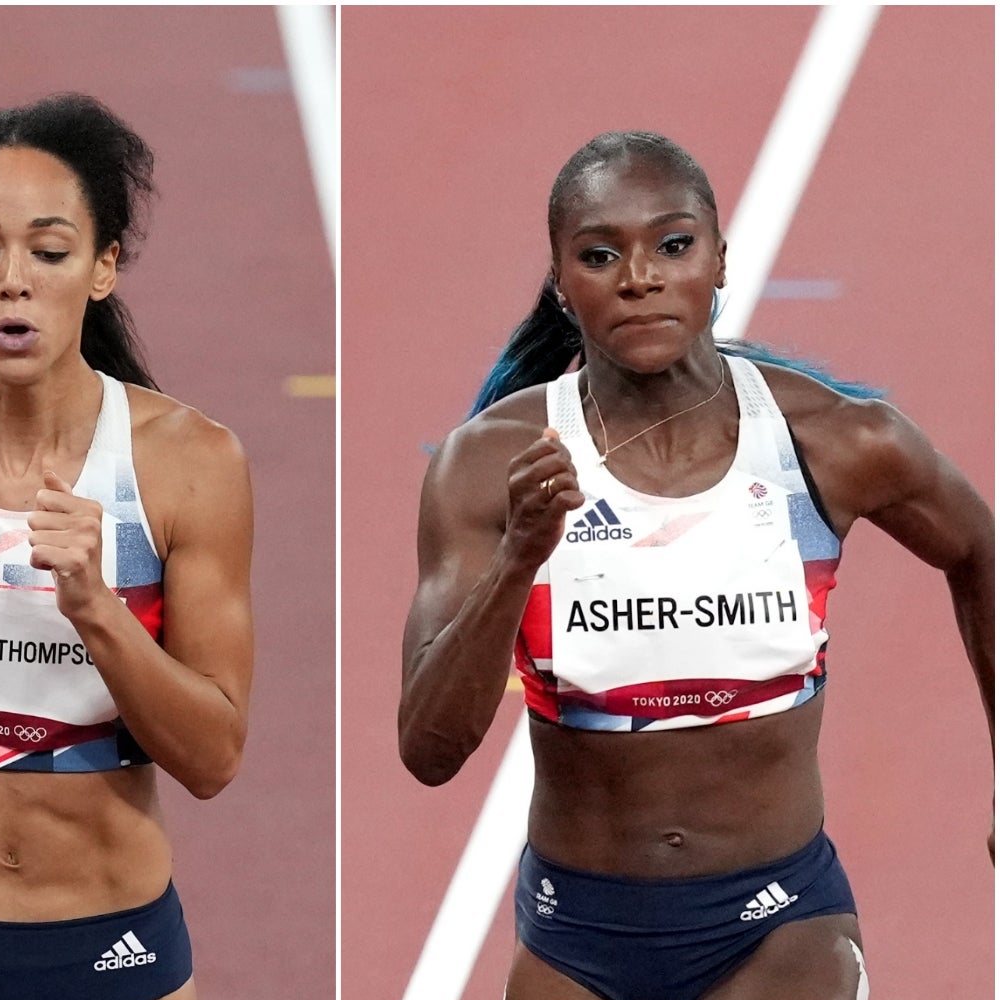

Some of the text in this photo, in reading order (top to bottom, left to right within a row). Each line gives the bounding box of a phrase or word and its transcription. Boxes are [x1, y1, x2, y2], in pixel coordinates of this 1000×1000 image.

[566, 525, 633, 543] adidas
[566, 590, 797, 633] ASHER-SMITH
[632, 694, 701, 707] TOKYO 2020
[93, 952, 157, 972] adidas
